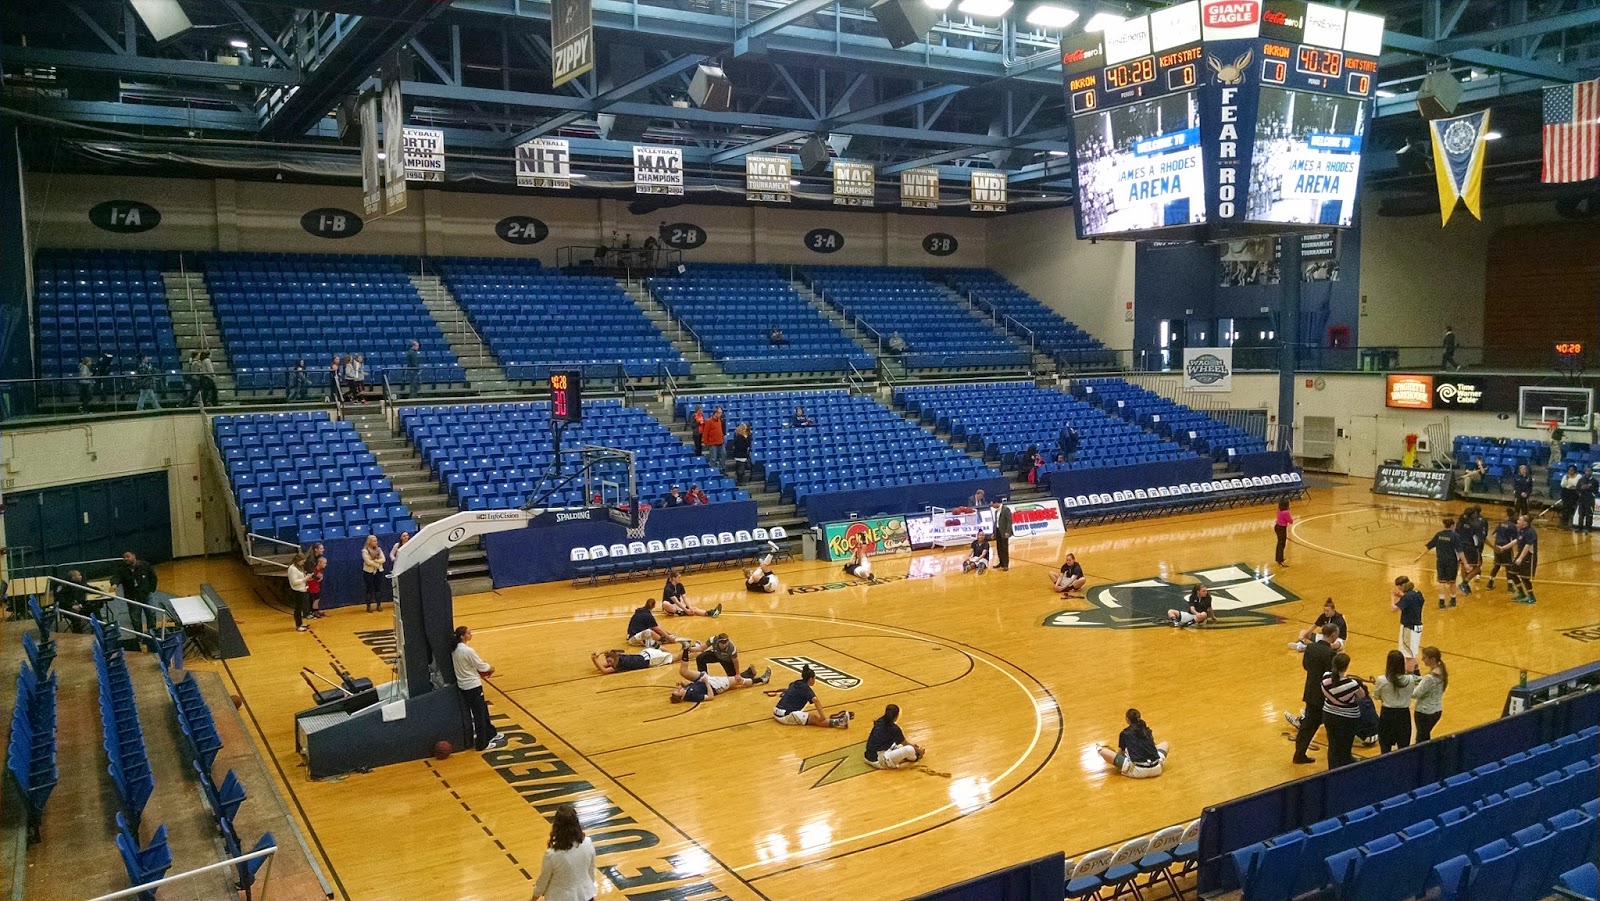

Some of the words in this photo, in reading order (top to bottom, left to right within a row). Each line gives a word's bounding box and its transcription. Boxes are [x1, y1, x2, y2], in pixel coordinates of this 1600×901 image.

[1208, 3, 1254, 14] GIANT
[1209, 13, 1252, 24] EAGLE
[555, 34, 588, 79] ZIPPY
[1159, 54, 1177, 68] KENT
[1177, 47, 1203, 64] STATE
[1264, 44, 1290, 58] AKRON
[1301, 51, 1340, 76] 40:28
[1344, 58, 1359, 70] KENT
[1359, 59, 1378, 73] STATE
[1108, 59, 1152, 87] 40:28
[1183, 67, 1193, 85] 0
[1276, 63, 1285, 81] 0
[1070, 75, 1096, 91] AKRON
[1359, 76, 1369, 94] 0
[1085, 91, 1095, 108] 0
[1219, 87, 1239, 159] FEAR
[402, 137, 437, 149] ORTH
[403, 147, 433, 158] TAR
[404, 159, 441, 169] AMPIONS
[518, 147, 567, 175] NIT
[638, 155, 679, 174] MAC
[1289, 159, 1315, 171] JAMES
[1317, 160, 1322, 171] A
[1326, 161, 1355, 173] RHODES
[749, 162, 788, 181] NCAA
[836, 168, 872, 187] MAC
[1118, 167, 1146, 183] JAMES
[1149, 165, 1155, 176] A
[1160, 156, 1196, 174] RHODES
[637, 173, 680, 183] CHAMPIONS
[748, 181, 789, 191] TOURNAMENT
[903, 174, 938, 198] WNIT
[1294, 174, 1340, 194] ARENA
[836, 187, 872, 196] CHAMPIONS
[973, 176, 1006, 202] WBI
[1128, 174, 1182, 202] ARENA
[1218, 167, 1236, 219] ROO
[111, 207, 142, 226] 1-A
[319, 214, 346, 232] 1-B
[507, 222, 537, 239] 2-A
[671, 229, 697, 244] 2-B
[813, 234, 836, 248] 3-A
[930, 238, 951, 251] 3-B
[1555, 343, 1582, 354] 40:28
[1187, 365, 1227, 375] WHEEL
[1457, 383, 1475, 391] Time
[1457, 390, 1482, 398] Warner
[554, 390, 567, 416] 30
[487, 512, 520, 520] InfoCision
[556, 511, 591, 523] SPALDING
[1013, 508, 1059, 524] NTROSE
[1029, 522, 1049, 530] GROUP
